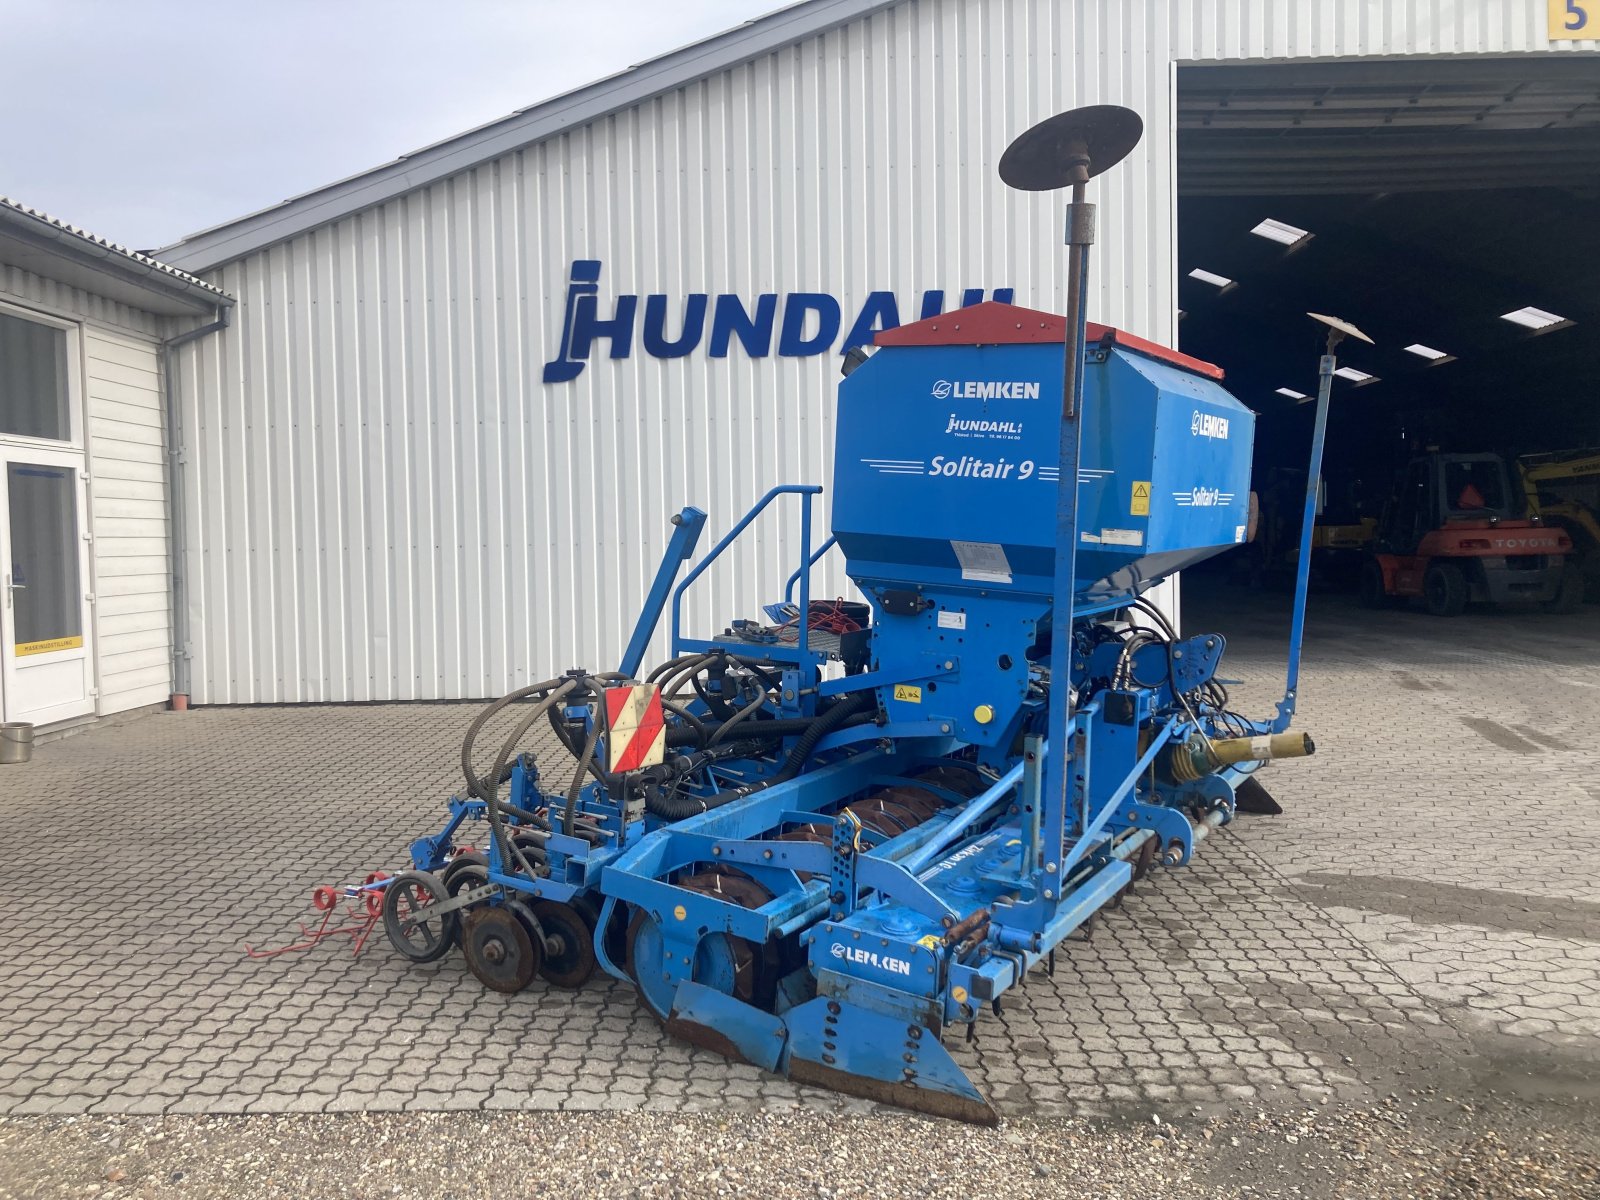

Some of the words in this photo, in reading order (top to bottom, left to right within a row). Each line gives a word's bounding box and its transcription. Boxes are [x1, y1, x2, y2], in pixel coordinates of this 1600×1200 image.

[1565, 0, 1588, 30] 5
[953, 381, 1040, 402] LEMKEN
[1199, 413, 1229, 441] LEMKEN
[928, 455, 1014, 479] Solitair
[1017, 460, 1035, 480] 9
[1191, 487, 1214, 506] Solitair
[1213, 488, 1219, 506] 9
[1495, 538, 1557, 548] TOYOTA
